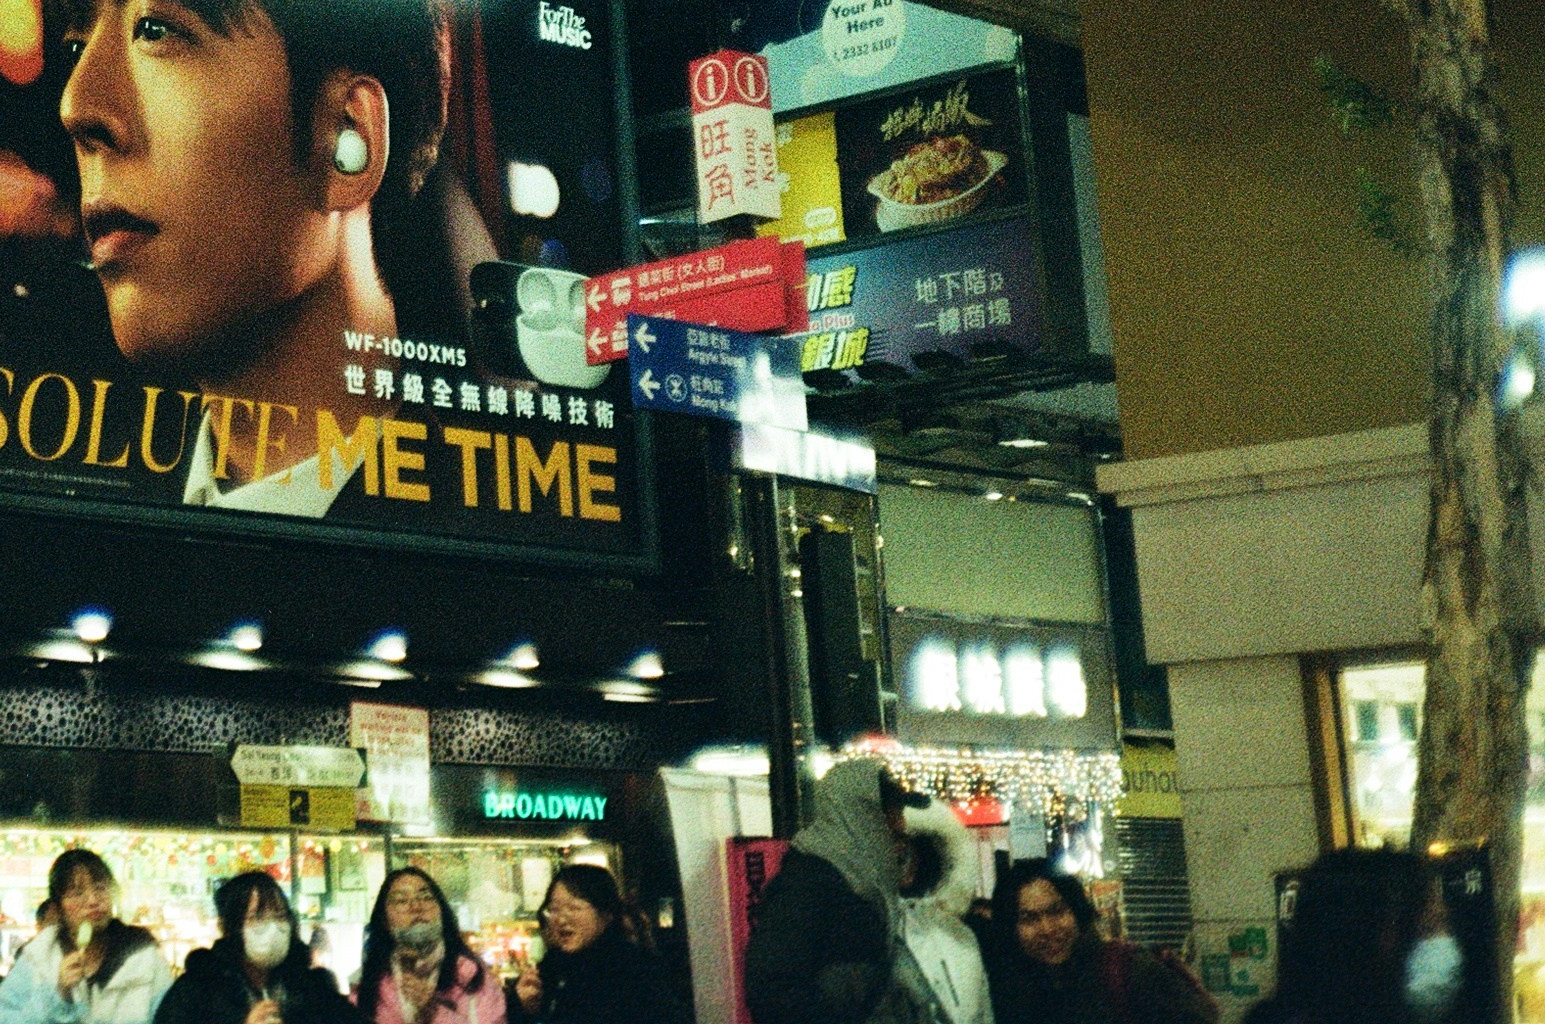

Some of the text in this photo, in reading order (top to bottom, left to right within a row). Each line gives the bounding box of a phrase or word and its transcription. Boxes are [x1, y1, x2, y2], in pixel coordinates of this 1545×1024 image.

[832, 4, 866, 19] Your
[847, 17, 885, 34] Here
[539, 20, 594, 52] MUSIC
[700, 120, 736, 212] 旺角
[743, 128, 760, 189] Mong
[759, 142, 776, 183] Kok
[344, 331, 468, 370] WF-1000XM5
[800, 326, 870, 372] 銀城
[345, 366, 617, 430] 世界級全無線降噪技術
[317, 410, 430, 504] ME
[443, 429, 623, 524] TIME
[484, 790, 608, 822] BROADWAY
